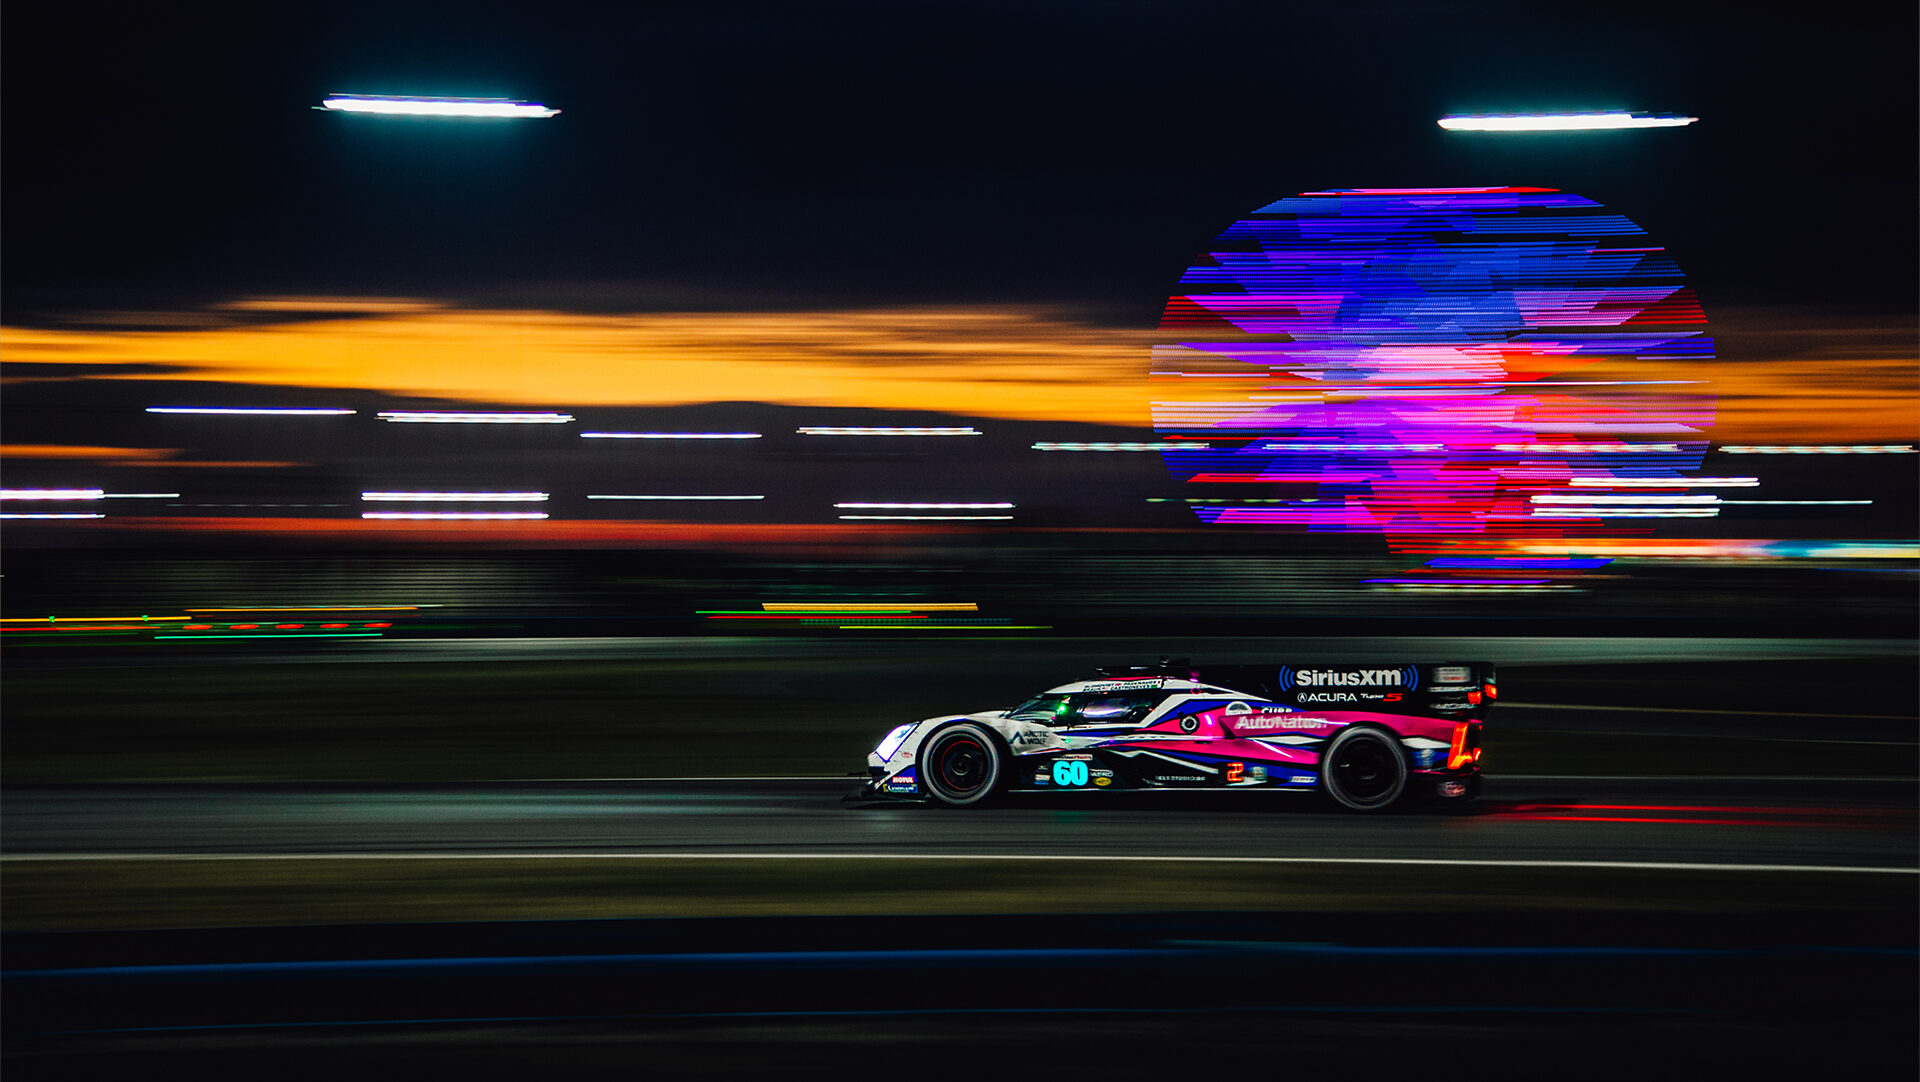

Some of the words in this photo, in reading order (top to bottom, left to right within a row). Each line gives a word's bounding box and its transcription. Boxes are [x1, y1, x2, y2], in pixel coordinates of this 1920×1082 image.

[1296, 669, 1401, 686] SiriusXM
[1307, 693, 1358, 702] ACURA
[1233, 716, 1328, 730] AutoNation
[1023, 730, 1049, 738] ARCTIC
[1053, 760, 1088, 786] 60
